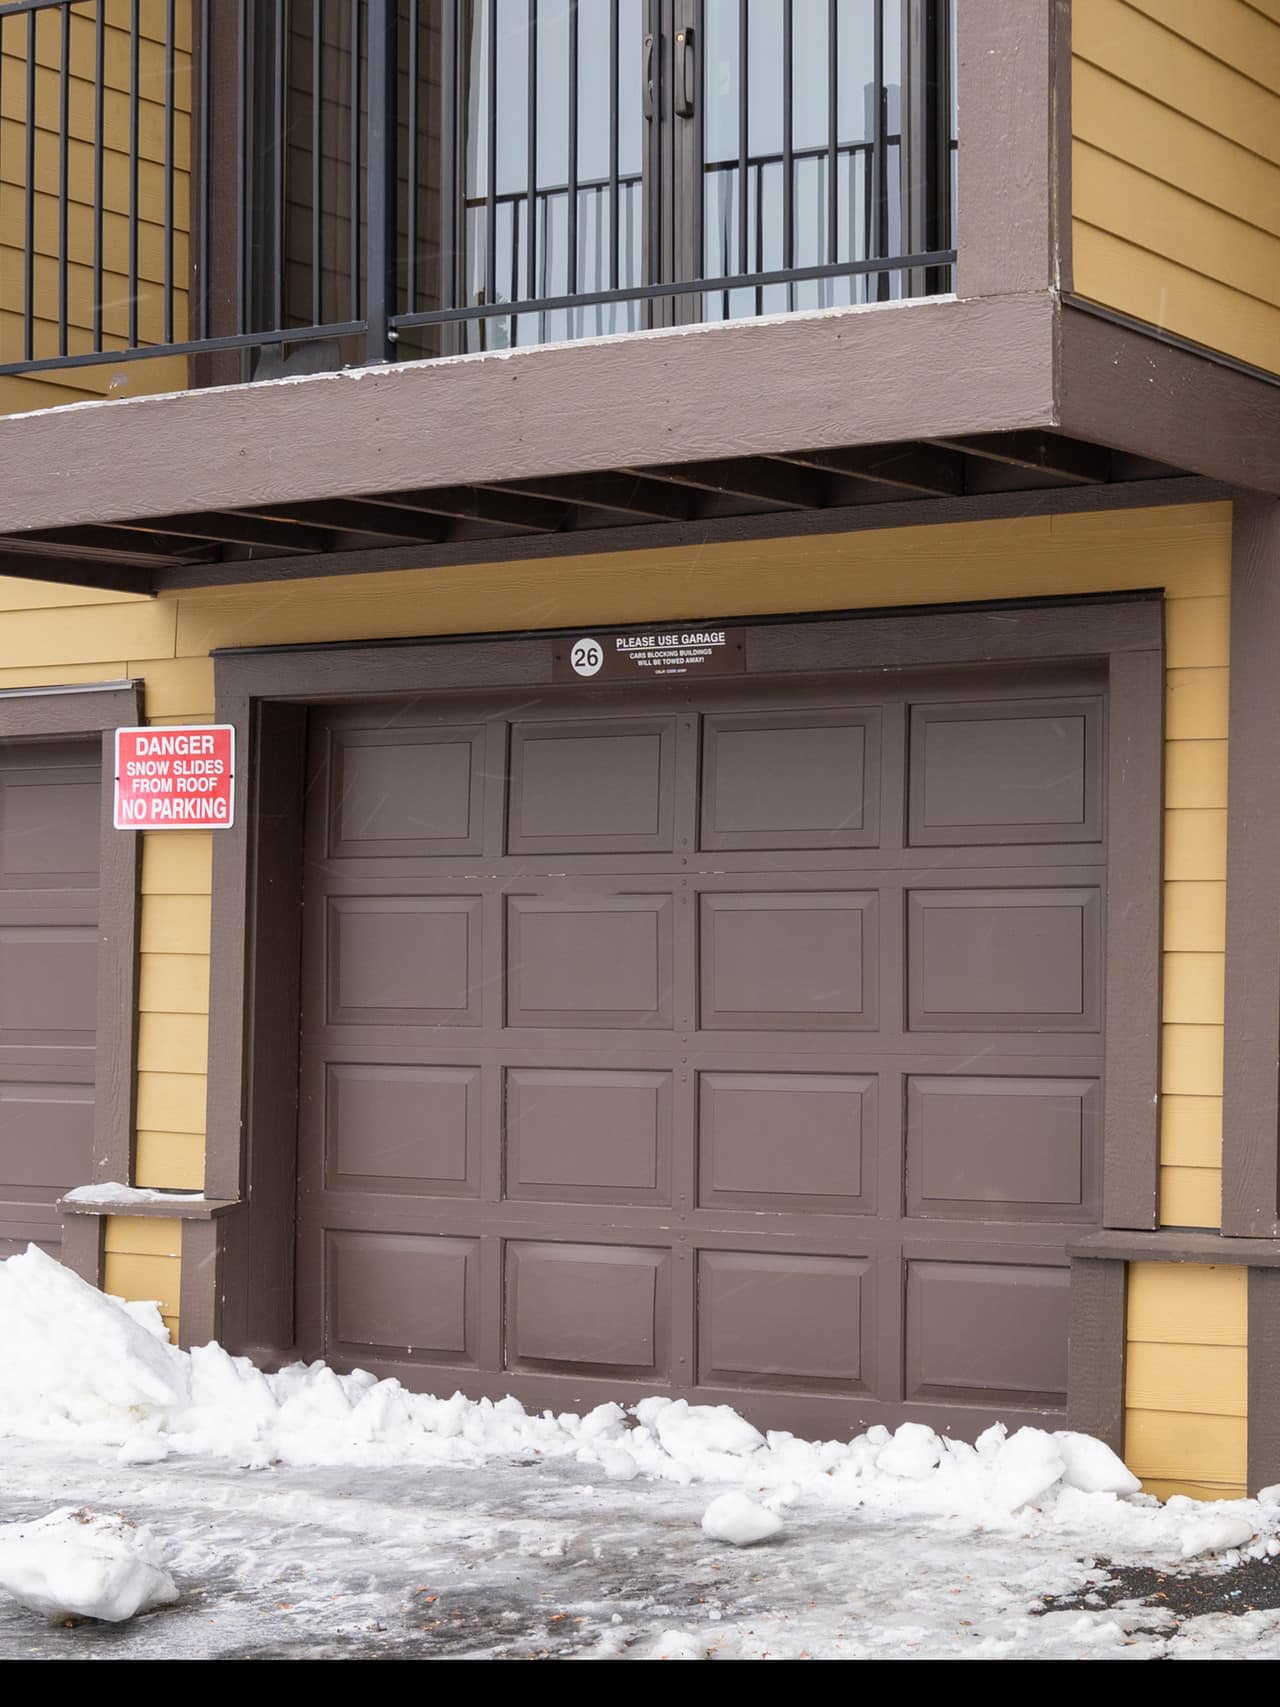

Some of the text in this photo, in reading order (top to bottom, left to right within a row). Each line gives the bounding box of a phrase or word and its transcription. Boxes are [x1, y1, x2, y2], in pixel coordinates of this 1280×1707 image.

[616, 632, 725, 648] PLEASE USE GARAGE
[574, 648, 599, 667] 26
[647, 650, 678, 658] BLOCKING
[680, 648, 712, 656] BUILDINGS
[135, 735, 215, 756] DANGER
[126, 759, 224, 776] SNOW SLIDES
[131, 777, 218, 792] FROM ROOF
[122, 797, 227, 820] NO PARKING
